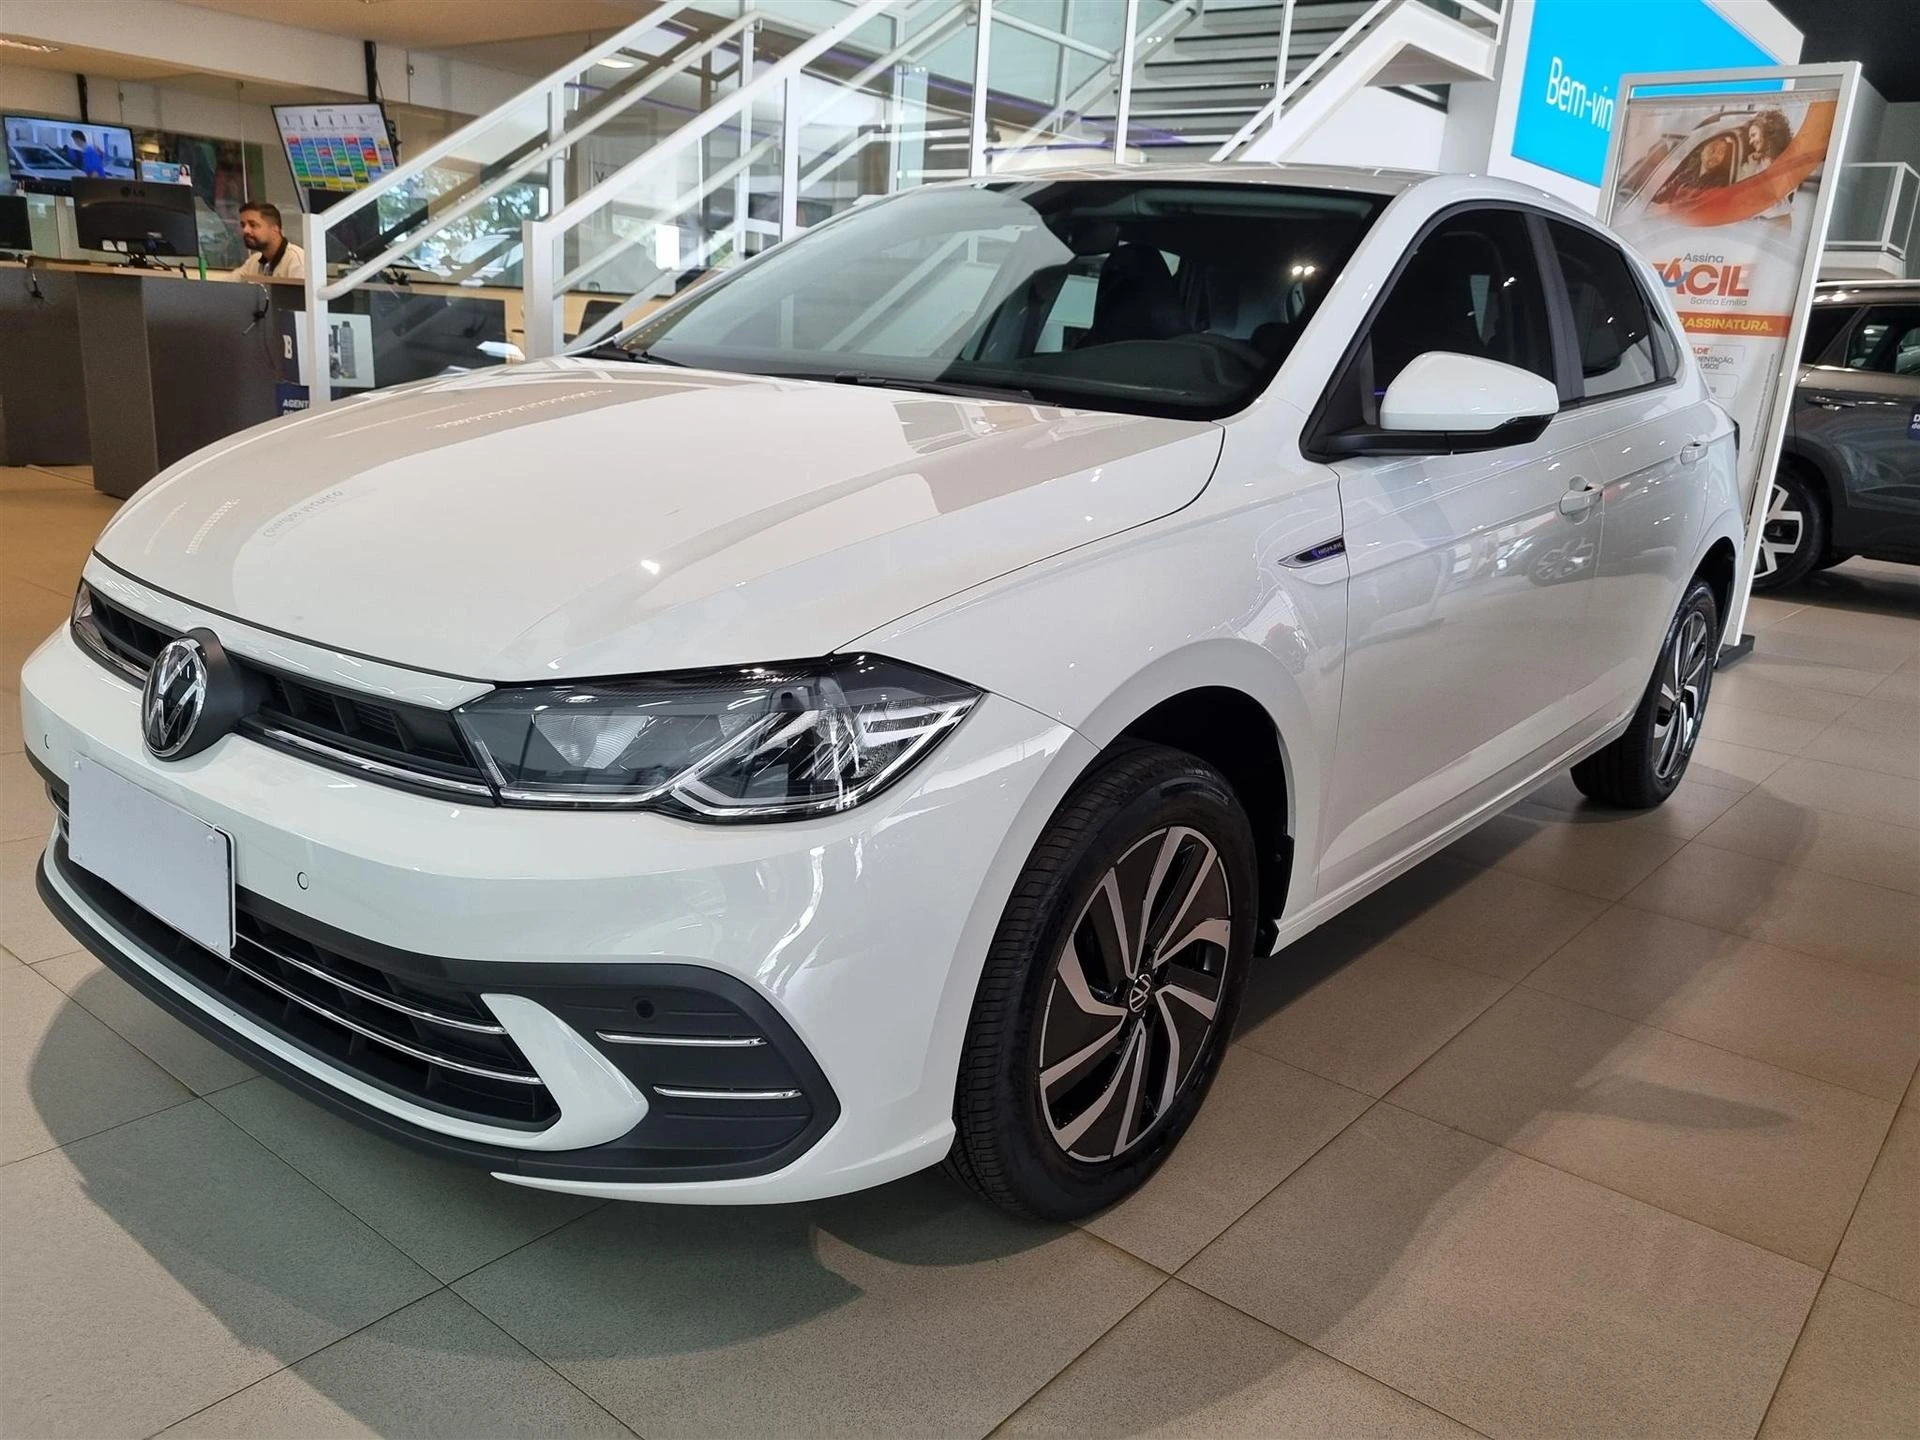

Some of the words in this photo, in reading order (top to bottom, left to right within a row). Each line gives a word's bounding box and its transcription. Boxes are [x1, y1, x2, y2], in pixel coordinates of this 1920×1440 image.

[1546, 56, 1614, 132] Bem-vin
[1683, 252, 1724, 263] Assina
[1690, 297, 1718, 306] Santa
